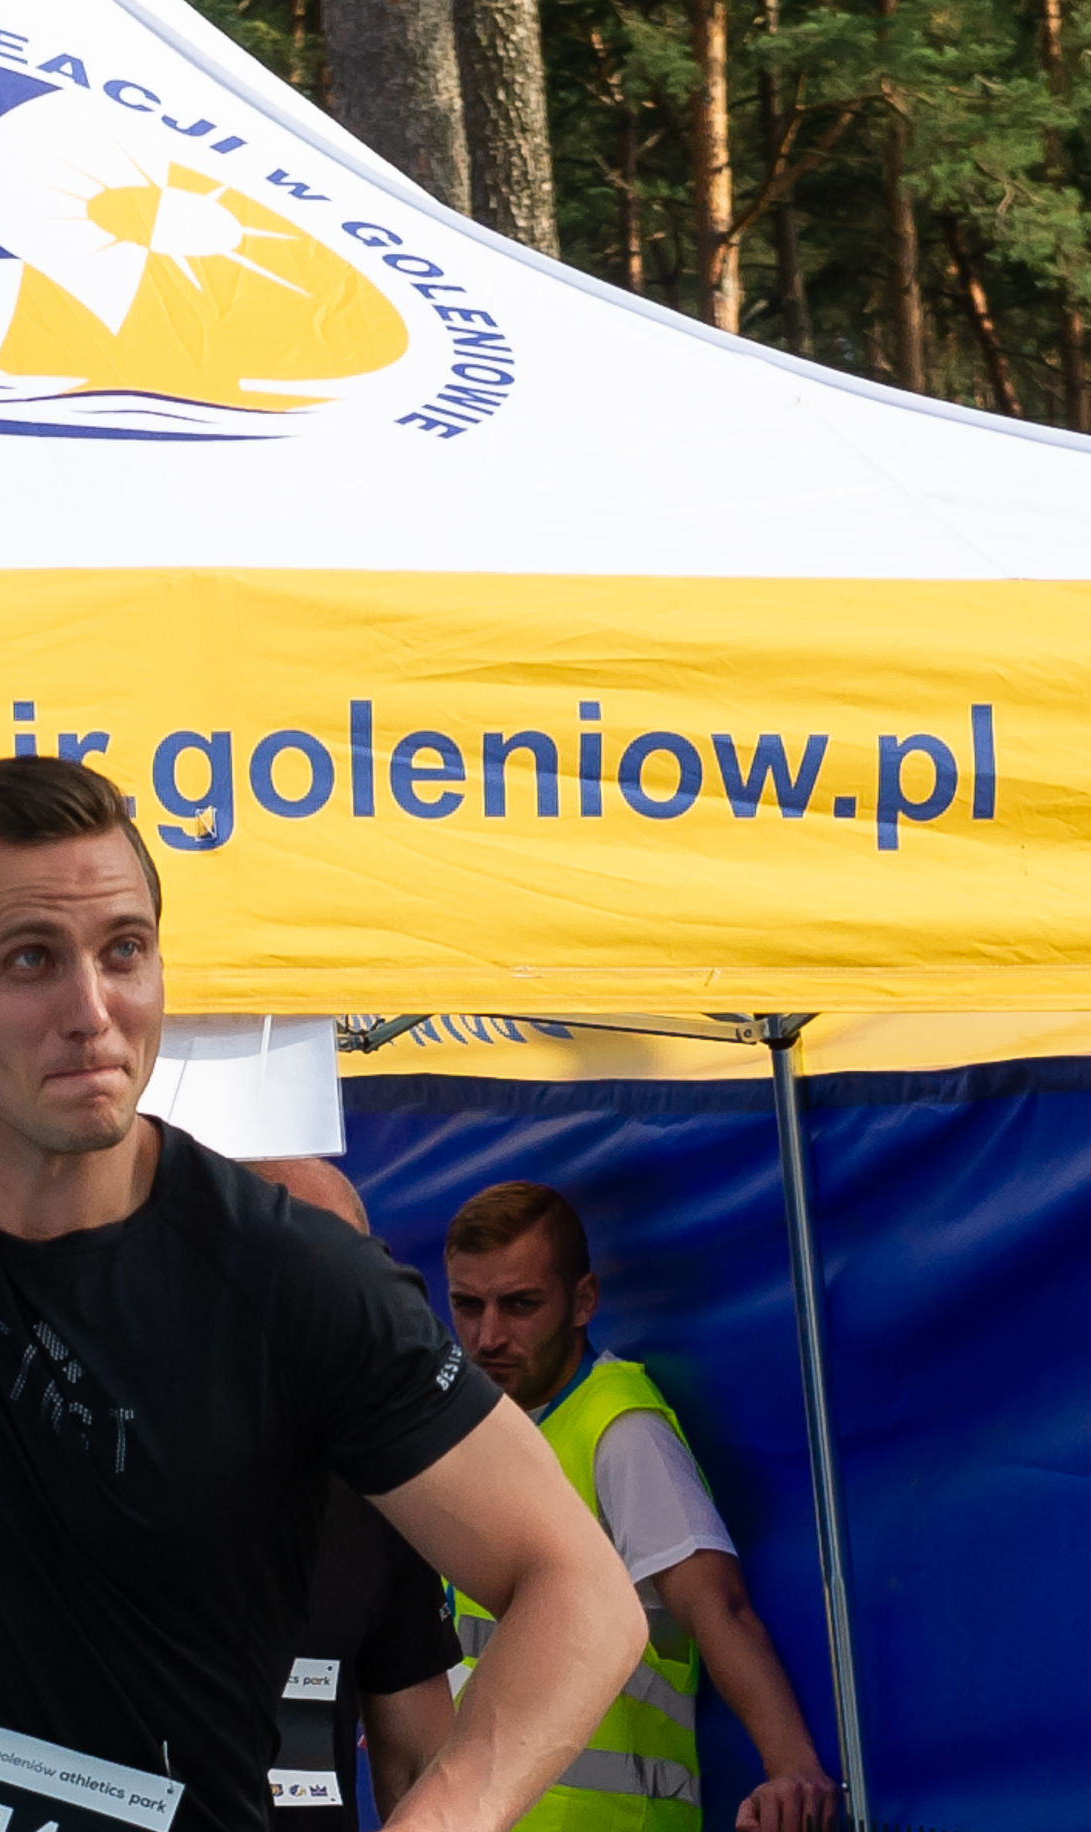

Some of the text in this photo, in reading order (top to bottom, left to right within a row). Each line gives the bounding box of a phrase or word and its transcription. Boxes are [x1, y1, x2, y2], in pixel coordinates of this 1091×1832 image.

[341, 220, 516, 439] GOLENIOWIE
[59, 1769, 126, 1800] athletics
[128, 1791, 168, 1815] park
